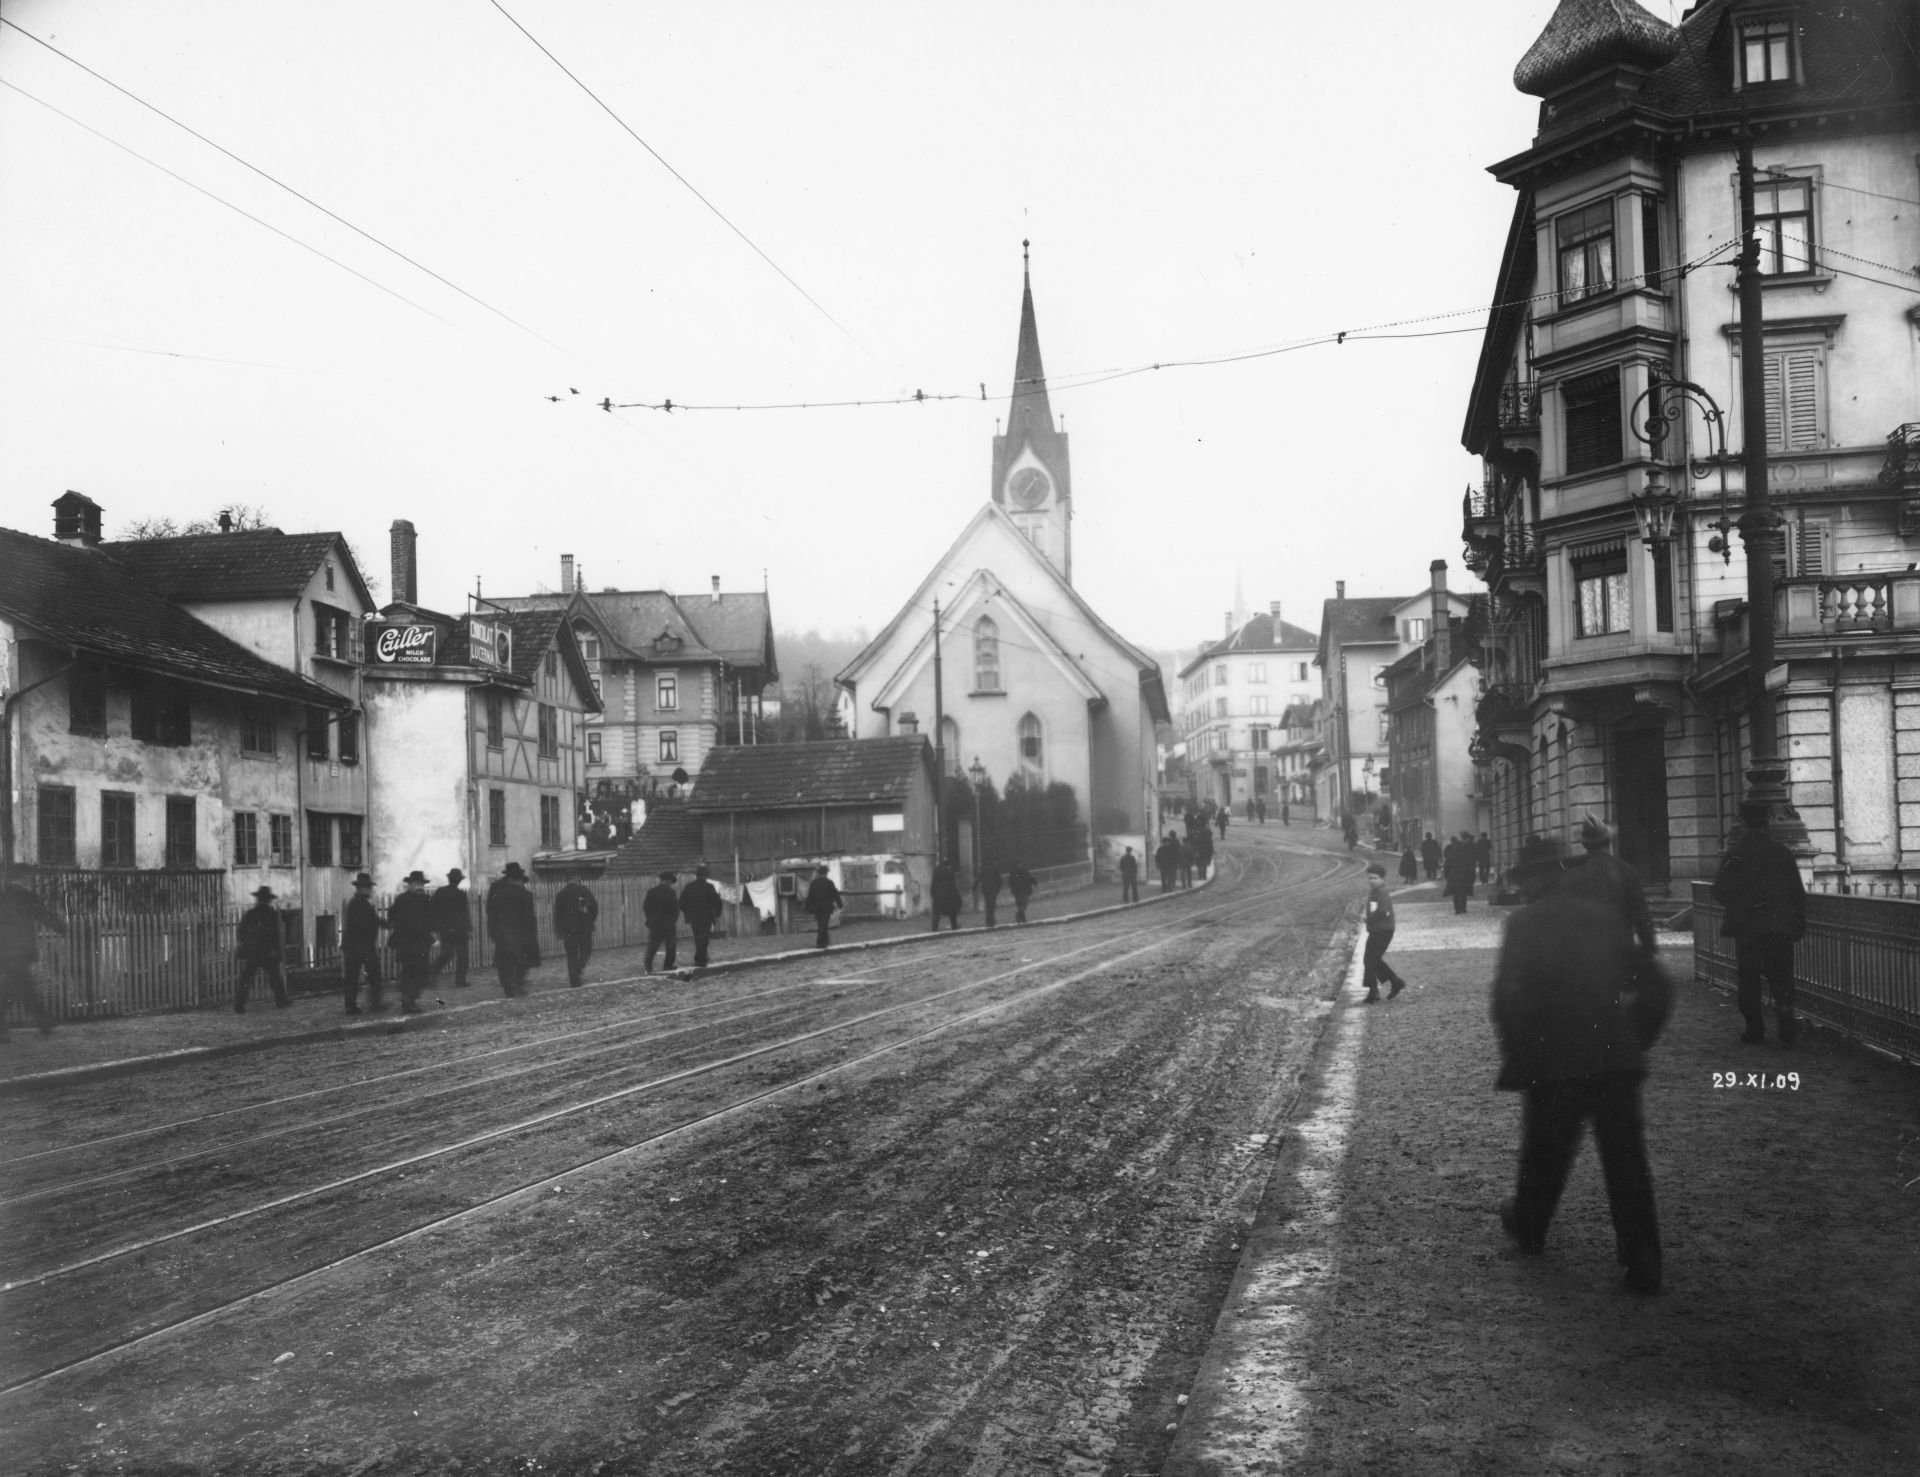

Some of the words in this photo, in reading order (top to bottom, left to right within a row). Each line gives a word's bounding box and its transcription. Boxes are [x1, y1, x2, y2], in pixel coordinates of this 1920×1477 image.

[377, 626, 434, 662] Cailler
[470, 620, 494, 645] CHOCOLAT
[470, 643, 495, 666] LUCERNA
